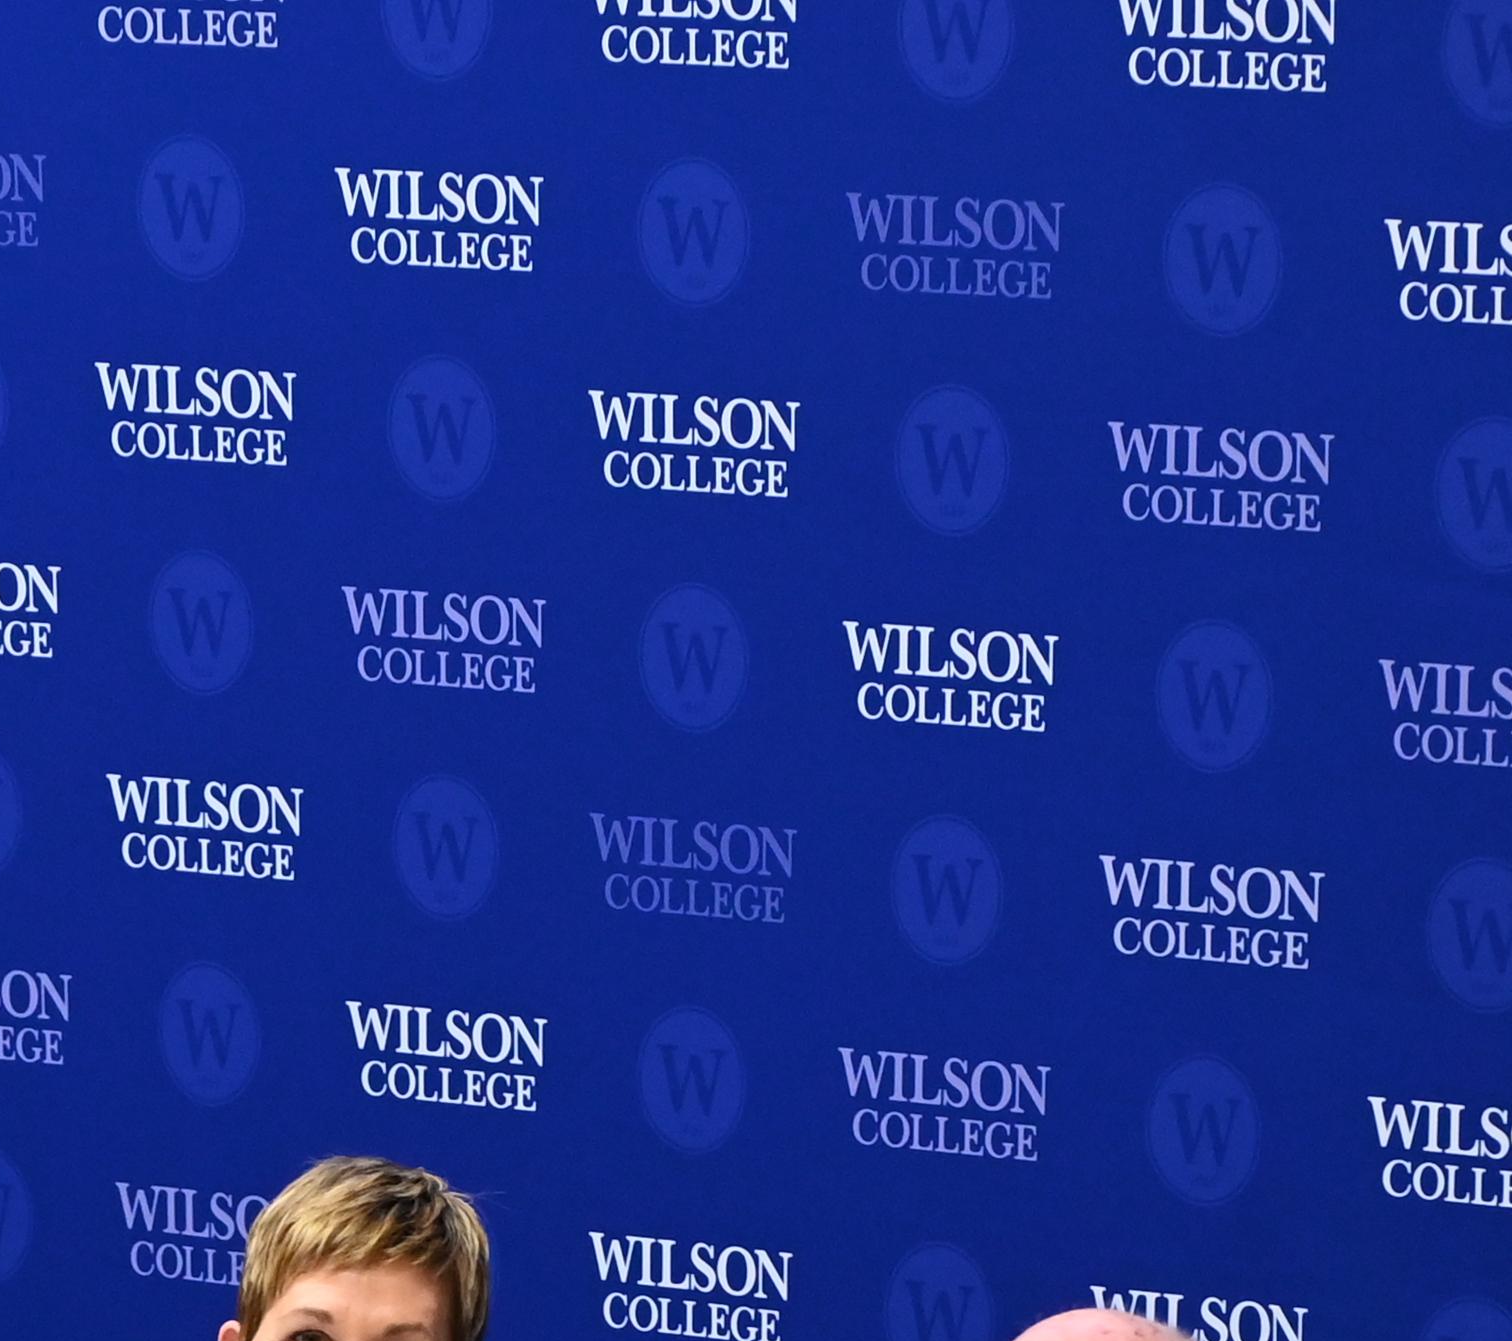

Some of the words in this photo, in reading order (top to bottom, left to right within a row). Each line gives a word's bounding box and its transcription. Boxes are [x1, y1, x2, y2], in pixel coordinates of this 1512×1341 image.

[98, 6, 278, 48] COLLEGE
[602, 25, 789, 69] COLLEGE
[1129, 47, 1326, 92] COLLEGE
[334, 167, 544, 226] WILSON
[848, 194, 1063, 250] WILSON
[351, 227, 532, 272] COLLEGE
[1190, 225, 1260, 295] W
[862, 255, 1050, 297] COLLEGE
[95, 362, 297, 421] WILSON
[111, 421, 287, 466] COLLEGE
[588, 390, 800, 452] WILSON
[604, 450, 788, 497] COLLEGE
[1108, 422, 1334, 484] WILSON
[1123, 484, 1320, 531] COLLEGE
[342, 586, 546, 648] WILSON
[358, 646, 535, 693] COLLEGE
[842, 621, 1059, 685] WILSON
[858, 682, 1045, 732] COLLEGE
[106, 774, 304, 836] WILSON
[122, 832, 294, 880] COLLEGE
[590, 813, 797, 877] WILSON
[605, 874, 785, 923] COLLEGE
[1099, 855, 1325, 922] WILSON
[1114, 917, 1309, 969] COLLEGE
[345, 1001, 548, 1067] WILSON
[361, 1060, 536, 1111] COLLEGE
[838, 1048, 1050, 1115] WILSON
[853, 1109, 1037, 1161] COLLEGE
[589, 1232, 793, 1301] WILSON
